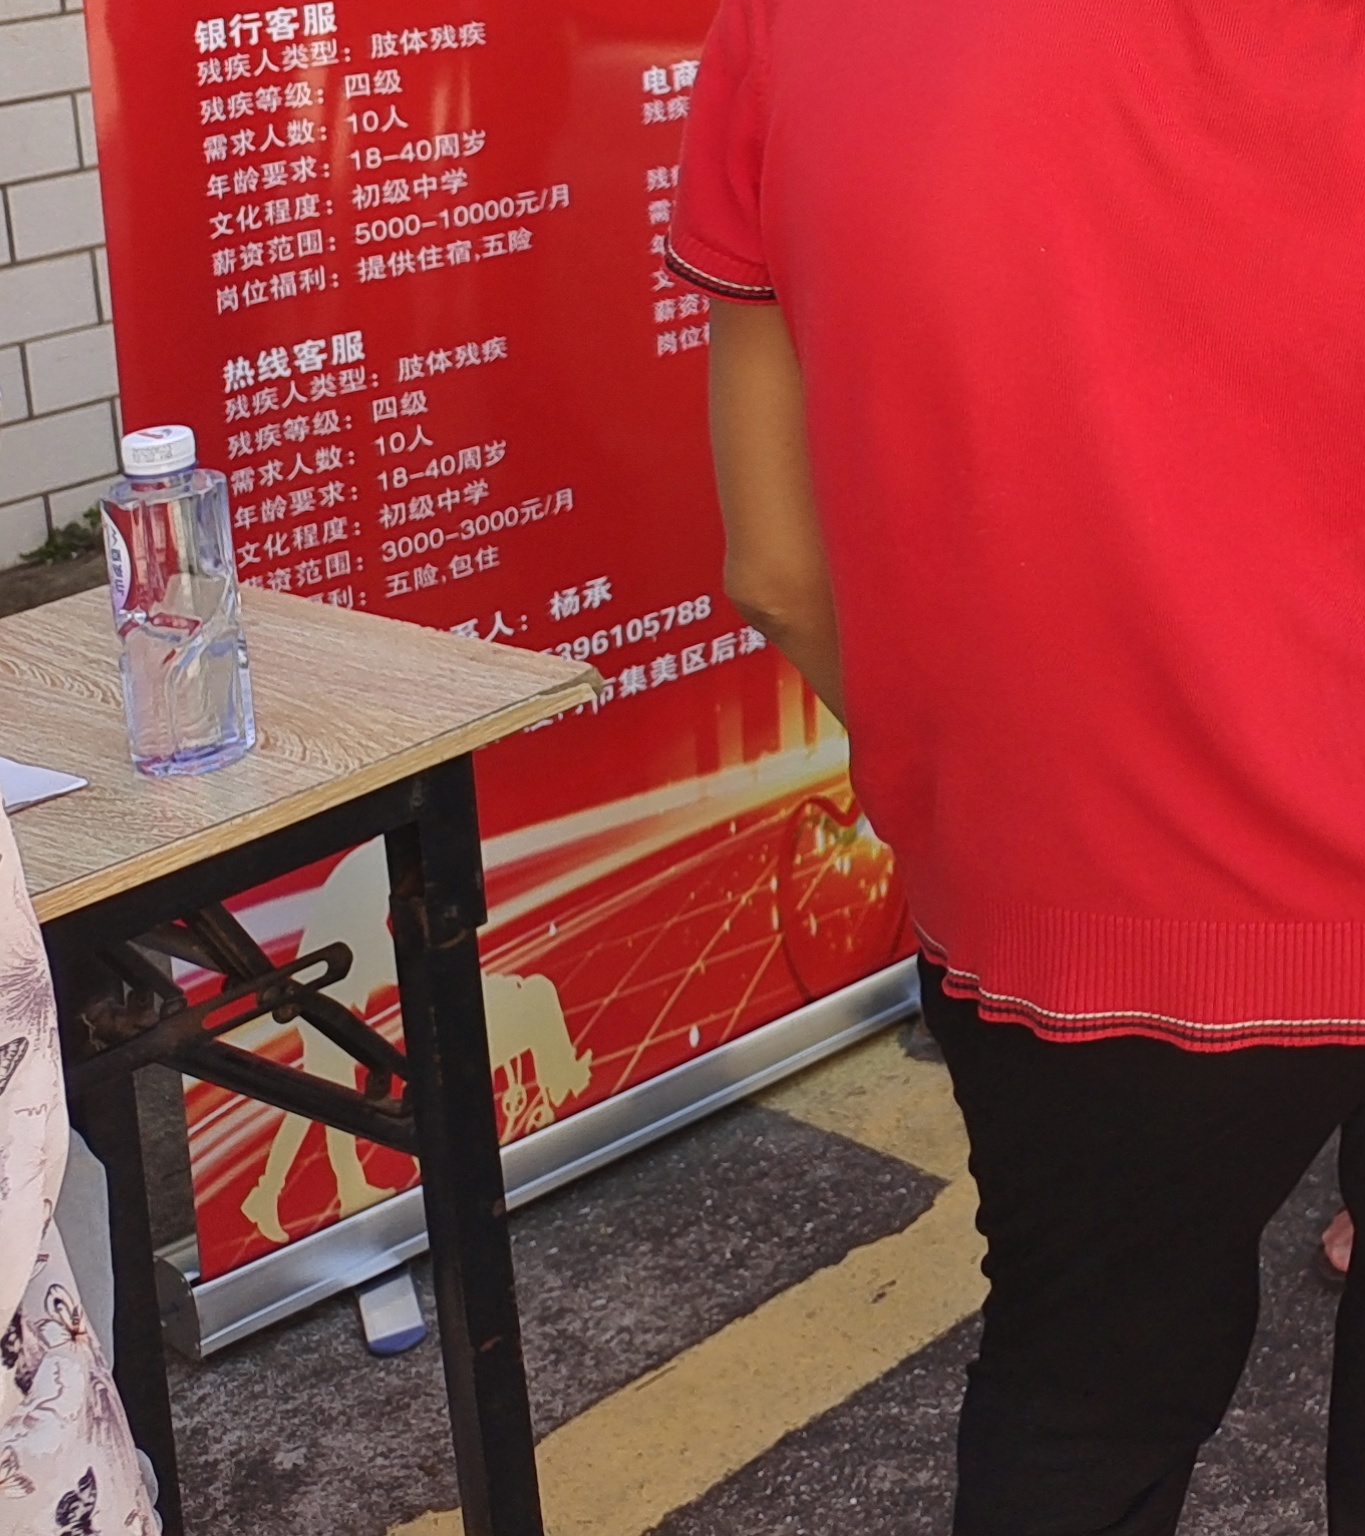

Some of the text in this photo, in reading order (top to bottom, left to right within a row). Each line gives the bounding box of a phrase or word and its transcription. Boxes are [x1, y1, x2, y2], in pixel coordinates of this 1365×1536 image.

[194, 0, 338, 54] 银行客服
[197, 20, 487, 87] 残疾人类型：肢体残疾
[200, 68, 403, 125] 残疾等级：四级
[203, 104, 409, 164] 需求人数：10人
[209, 167, 468, 240] 文化程度：初级中学
[222, 330, 366, 394] 热线客服
[225, 335, 509, 424] 残疾人类型：肢体残疾
[227, 389, 429, 460] 残疾等级：四级
[230, 423, 434, 497] 需求人数：10人
[236, 478, 490, 569] 文化程度：初级中学
[540, 594, 713, 664] 396105788
